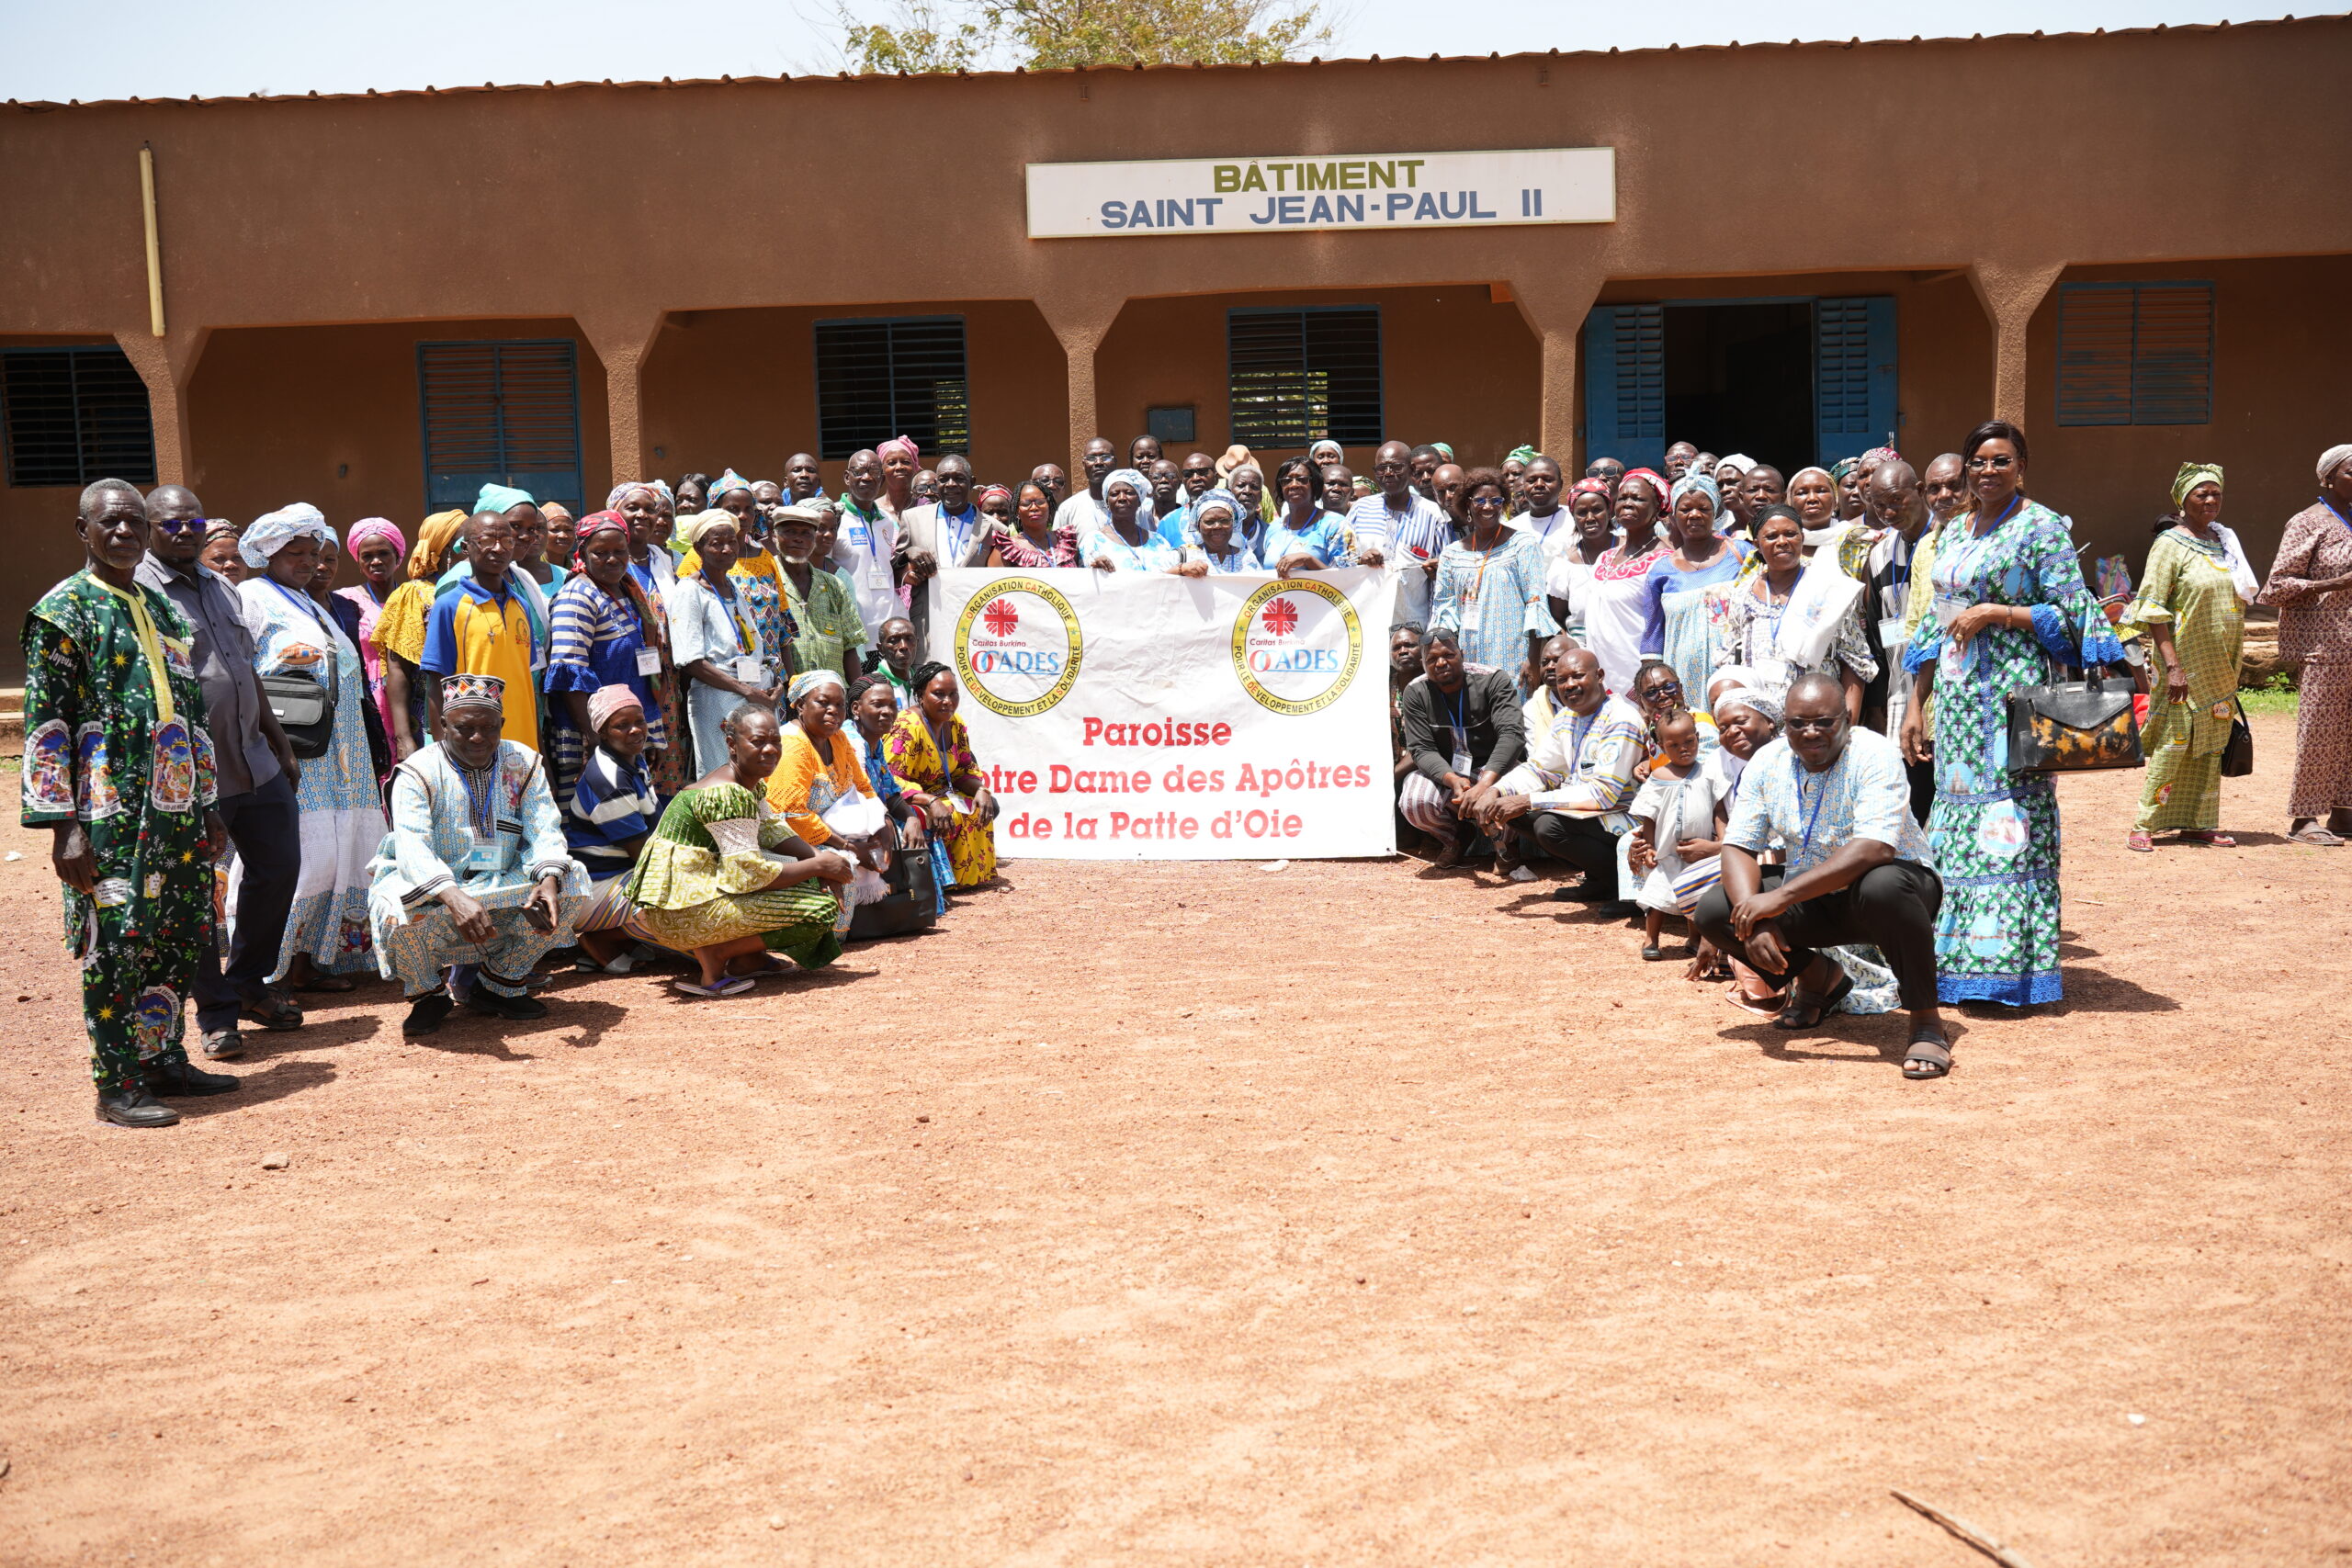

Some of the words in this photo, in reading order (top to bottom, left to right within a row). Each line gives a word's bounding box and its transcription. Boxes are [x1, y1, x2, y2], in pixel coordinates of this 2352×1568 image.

[1214, 159, 1425, 194] BÂTIMENT
[1101, 197, 1223, 229] SAINT
[1249, 190, 1497, 225] JEAN-PAUL
[1521, 188, 1543, 218] II
[967, 581, 1023, 619] ORGANISATION
[1025, 581, 1072, 621] CATHOLIQUE
[1244, 581, 1303, 618] ORGANISATION
[1305, 582, 1352, 619] CATHOLIQUE
[972, 650, 1059, 674] OCADES
[1235, 646, 1245, 671] POUR
[1240, 671, 1250, 682] LE
[1247, 682, 1314, 713] DÉVELOPPEMENT
[1316, 698, 1325, 708] ET
[1327, 691, 1338, 702] LA
[1336, 642, 1360, 693] SOLIDARITÉ
[1250, 649, 1339, 672] OCADES
[957, 647, 968, 671] POUR
[963, 672, 974, 683] LE
[970, 682, 1035, 715] DÉVELOPPEMENT
[1037, 700, 1047, 710] ET
[1048, 694, 1059, 705] LA
[1057, 645, 1080, 695] SOLIDARITÉ
[1083, 716, 1232, 746] Paroisse
[1049, 764, 1152, 794] Dame
[1163, 764, 1225, 793] des
[1236, 759, 1371, 797] Apôtres
[1009, 812, 1053, 840] de
[1063, 812, 1098, 840] la
[1110, 811, 1199, 840] Patte
